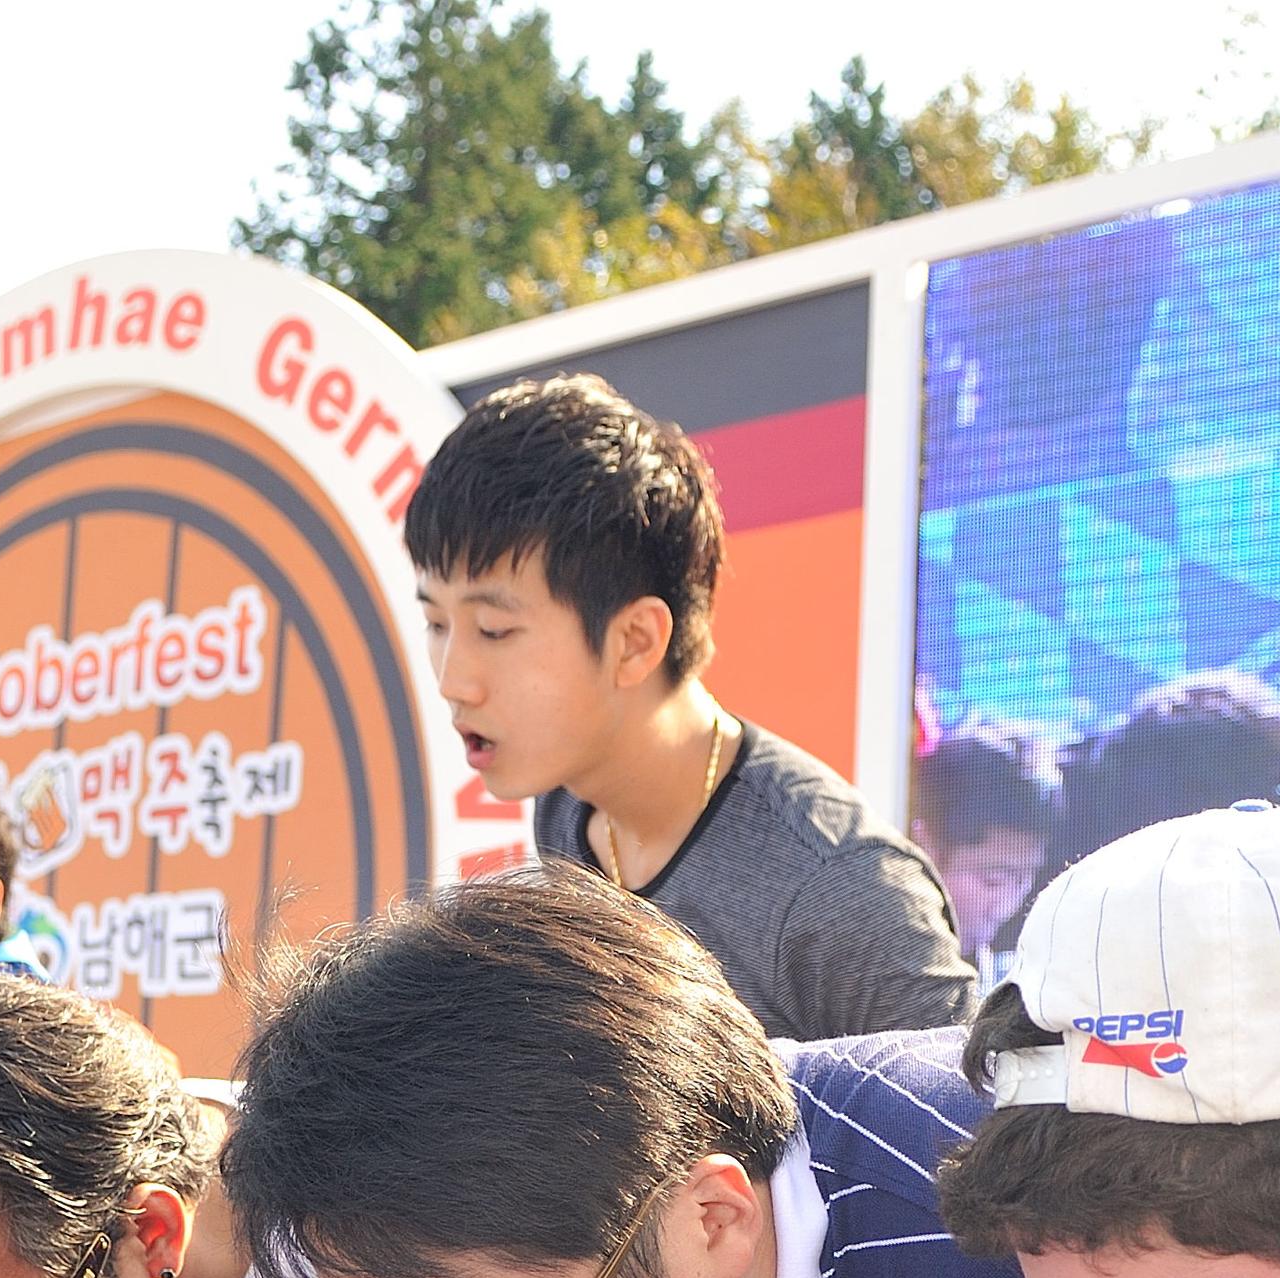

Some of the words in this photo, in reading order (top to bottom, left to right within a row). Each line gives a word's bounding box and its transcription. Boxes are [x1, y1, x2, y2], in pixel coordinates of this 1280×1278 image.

[256, 317, 426, 523] Germ
[78, 900, 217, 989] 남해군
[1073, 1009, 1184, 1042] PEPSI
